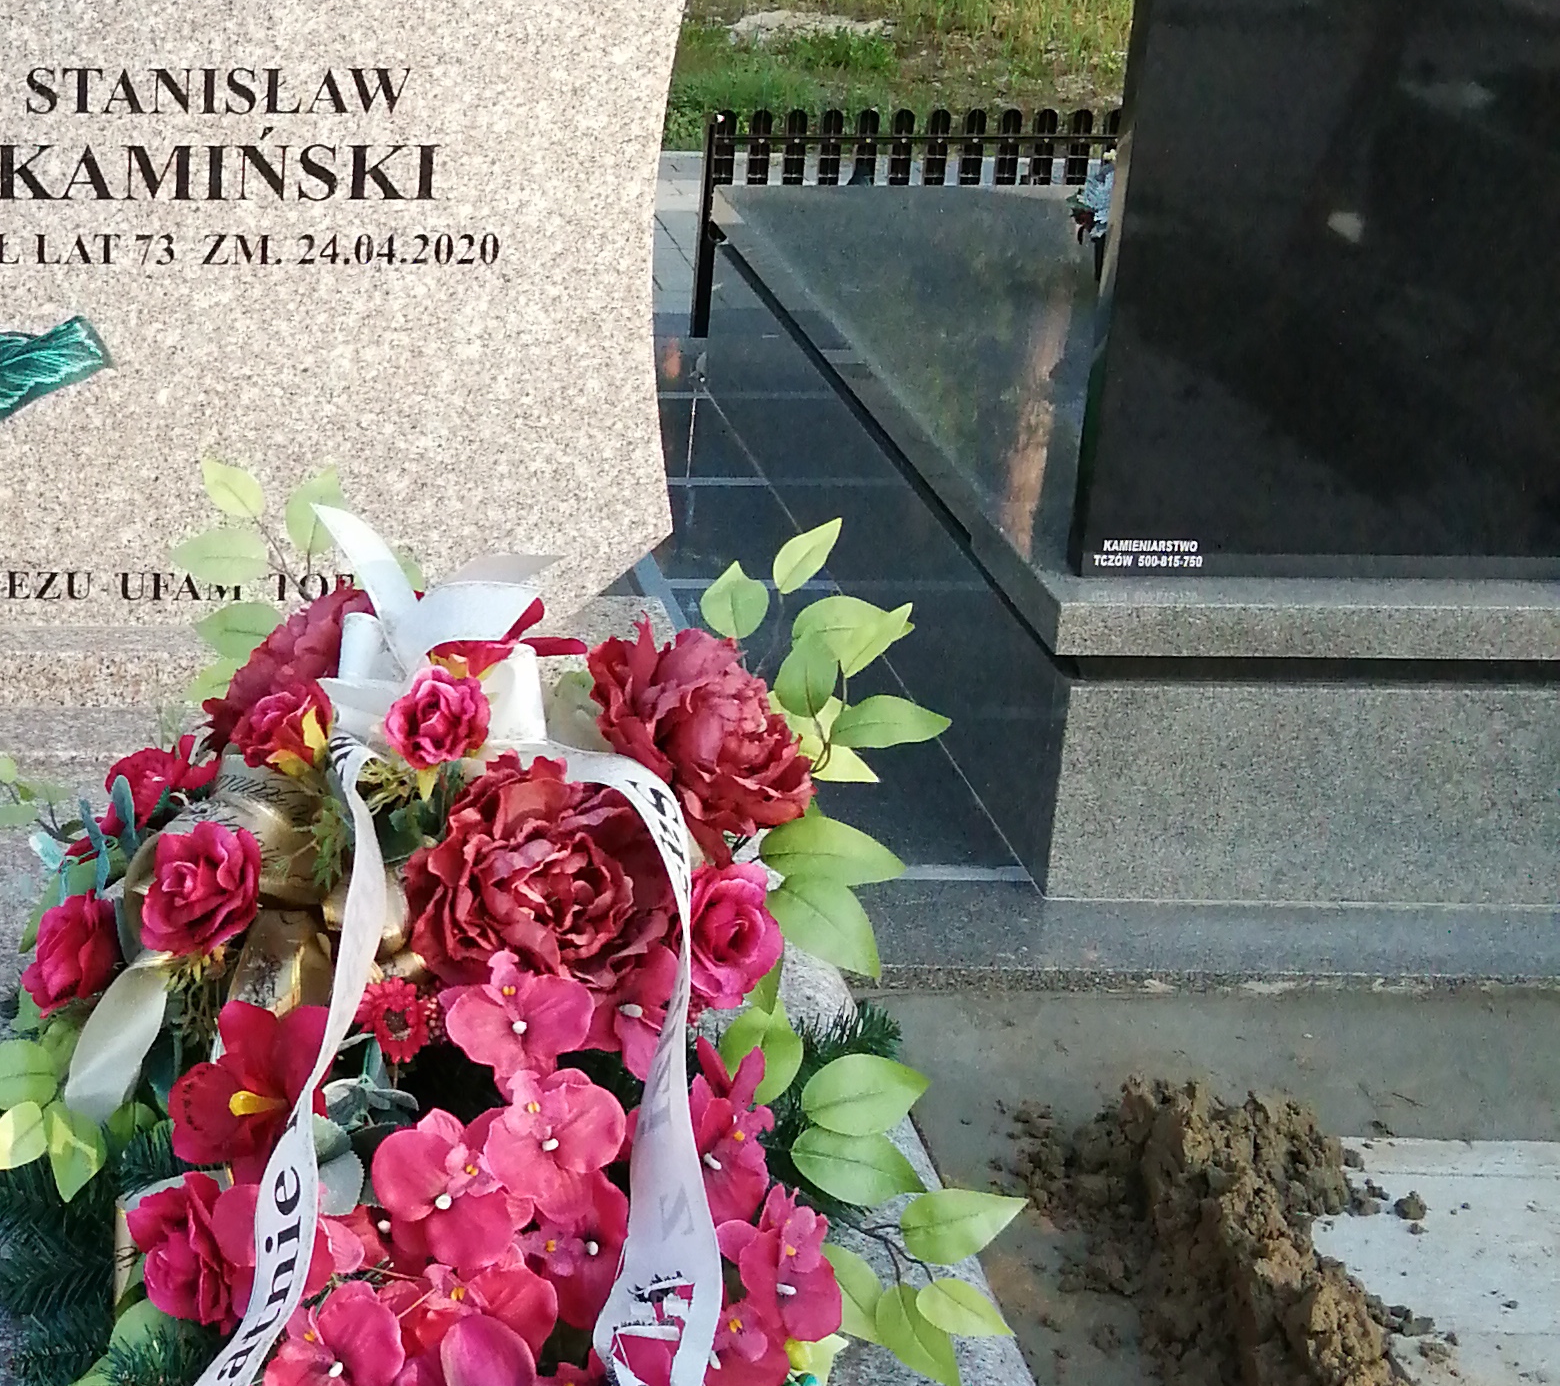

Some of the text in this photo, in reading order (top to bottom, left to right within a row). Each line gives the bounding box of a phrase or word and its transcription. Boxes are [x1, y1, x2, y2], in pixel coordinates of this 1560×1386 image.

[25, 66, 412, 116] STANISŁAW
[36, 233, 122, 265] LAT
[135, 233, 176, 266] 73
[202, 233, 283, 266] ZM.
[296, 233, 501, 266] 24.04.2020
[1102, 538, 1199, 553] KAMIENIARSTWO
[1093, 552, 1134, 568] TCZÓW
